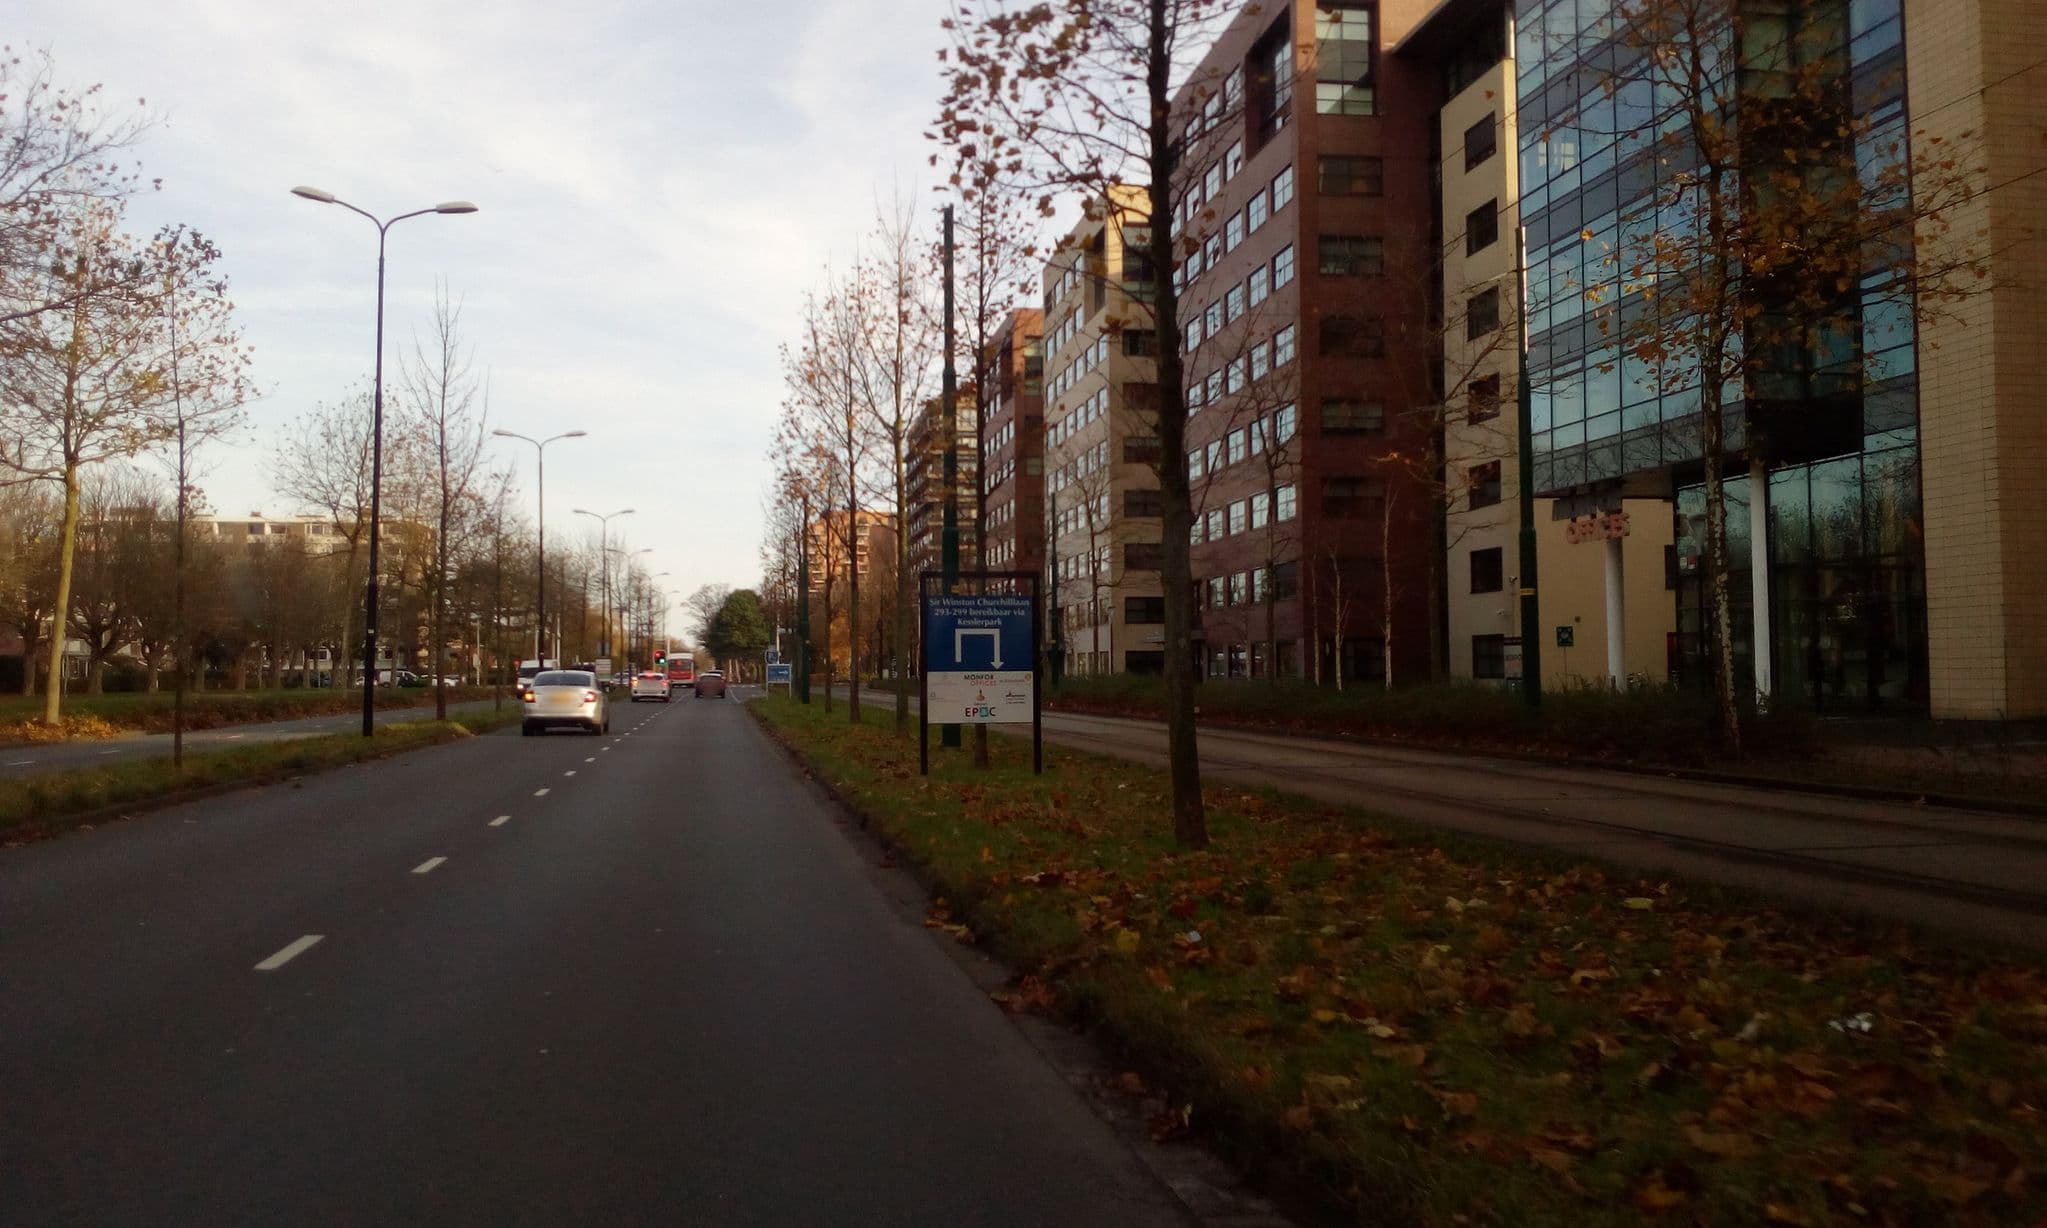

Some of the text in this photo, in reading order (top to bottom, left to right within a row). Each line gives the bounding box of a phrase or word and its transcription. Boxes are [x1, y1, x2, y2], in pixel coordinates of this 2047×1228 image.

[977, 598, 1030, 606] Churchilllaan
[969, 608, 1011, 616] bereikbaar
[1012, 608, 1025, 616] via
